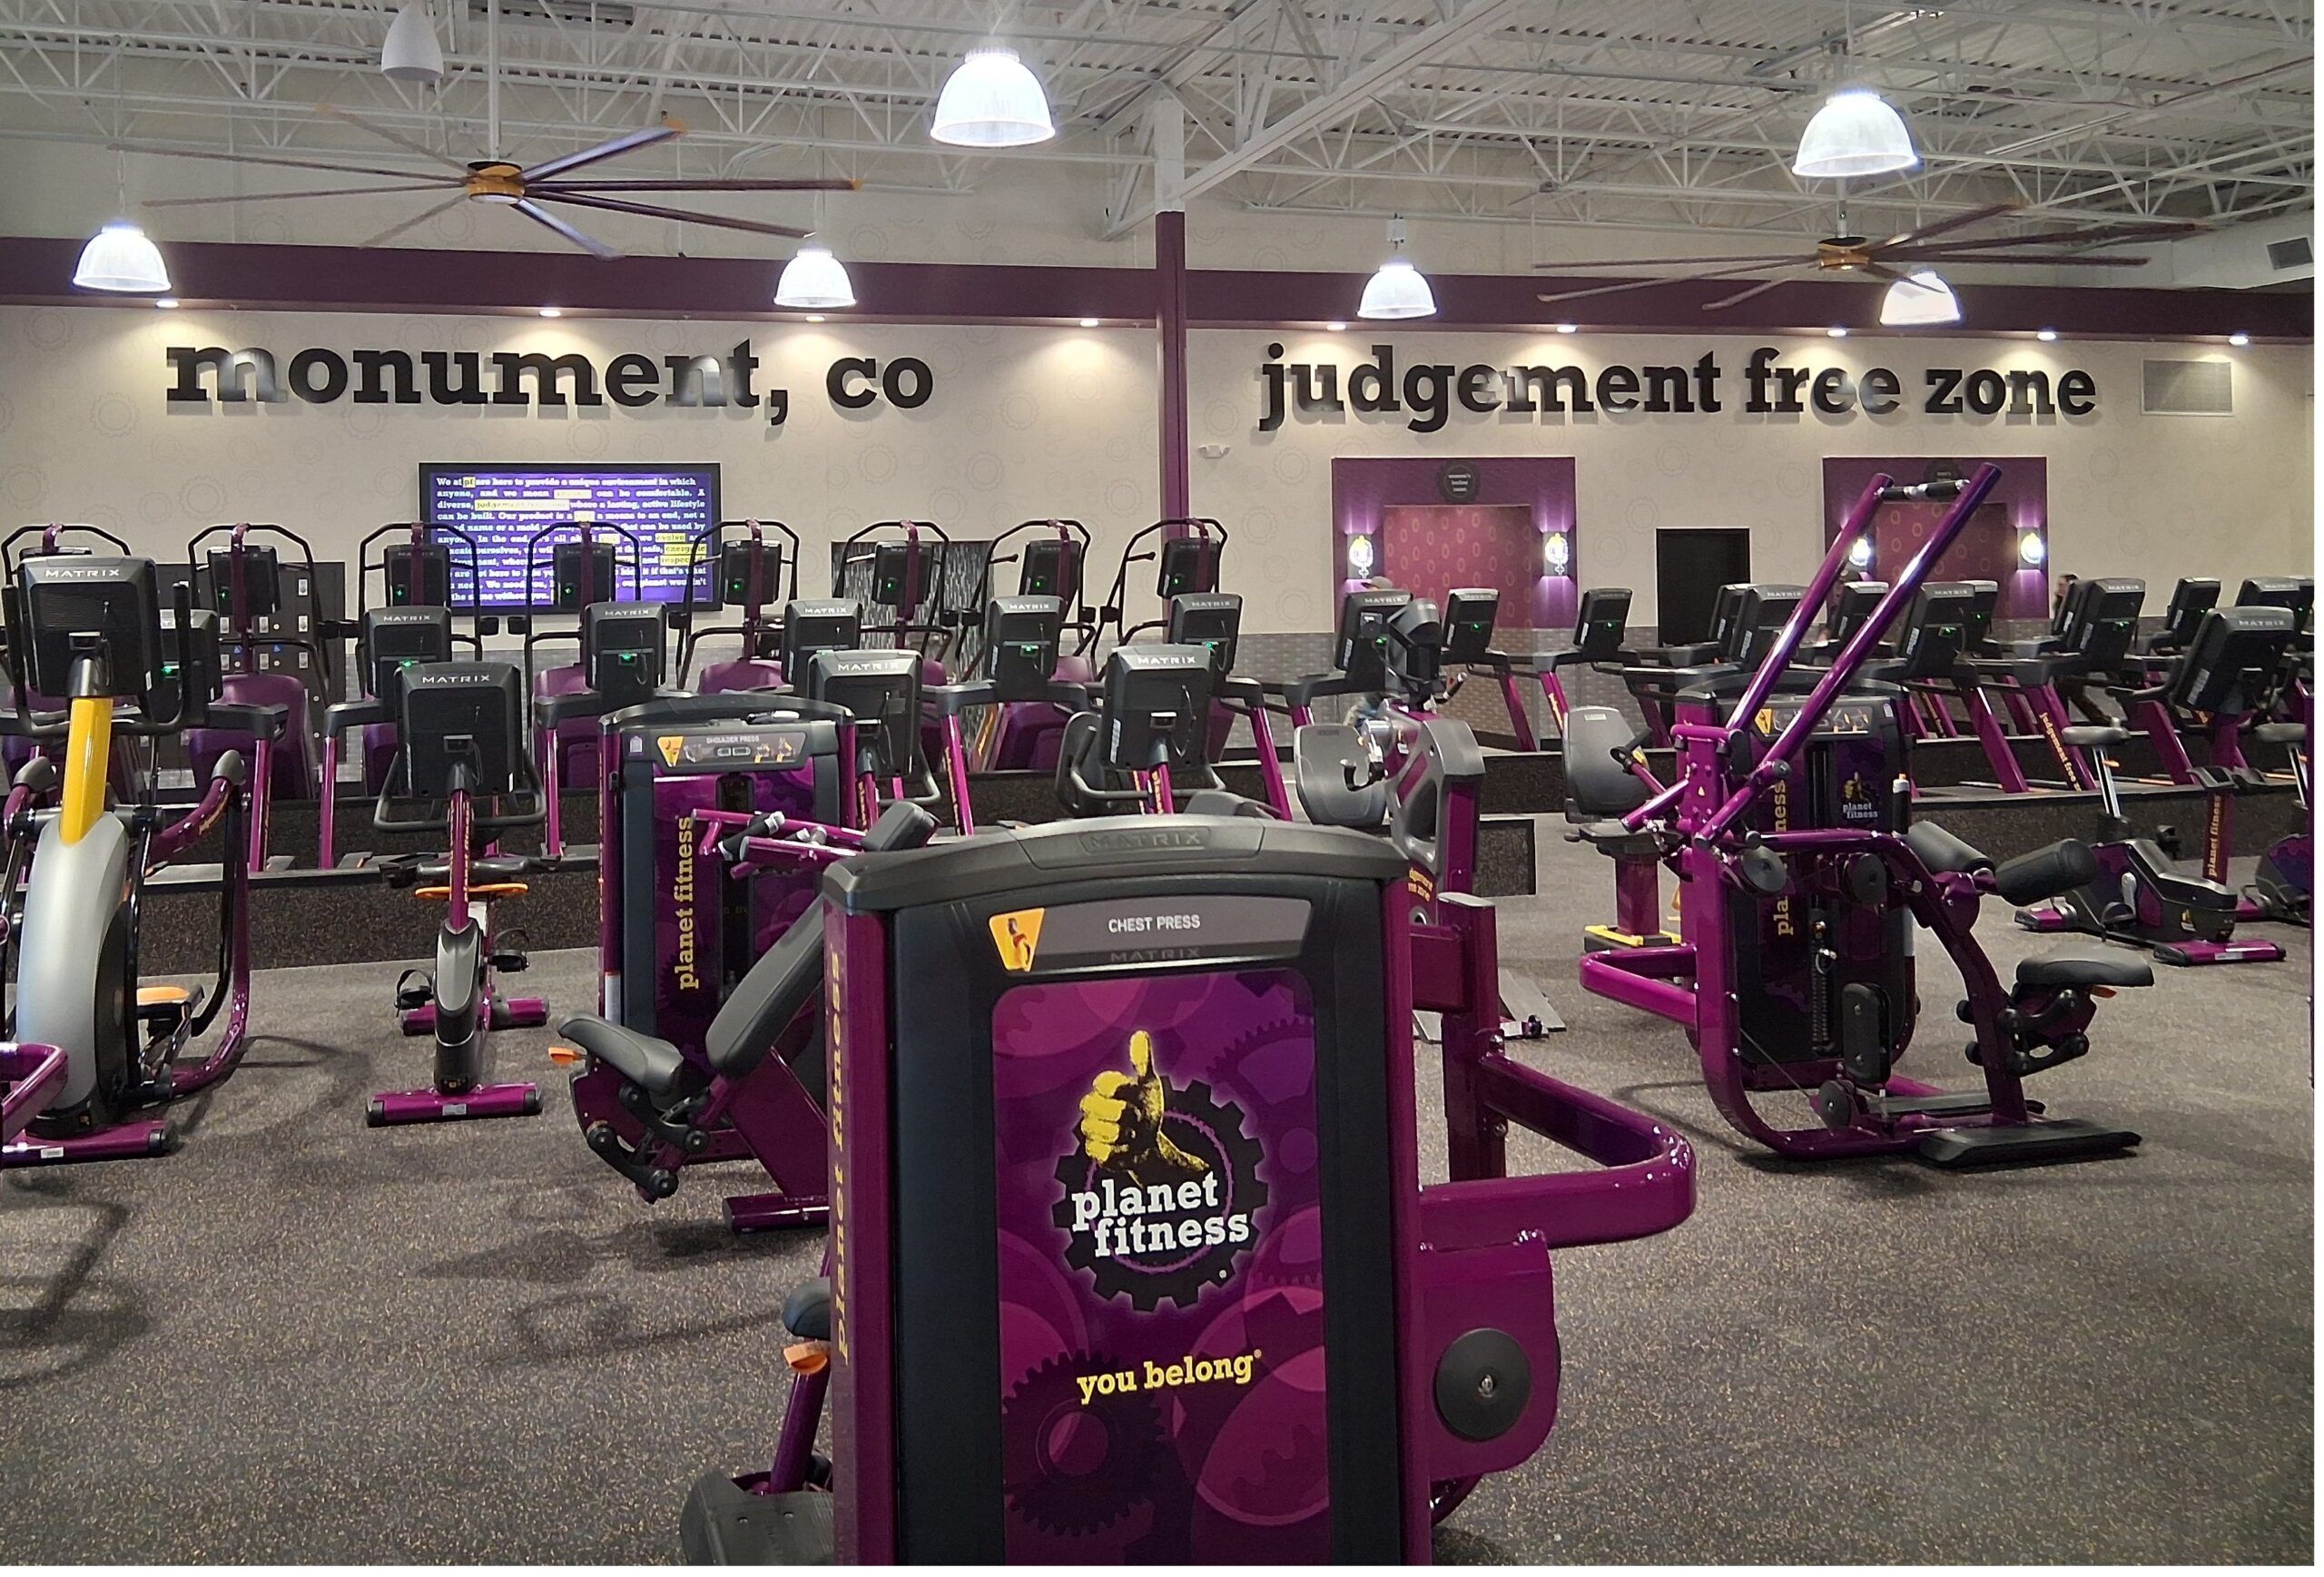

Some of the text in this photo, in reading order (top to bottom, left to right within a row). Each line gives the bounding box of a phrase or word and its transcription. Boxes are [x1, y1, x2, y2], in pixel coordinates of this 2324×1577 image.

[166, 338, 934, 426] monument, co
[1258, 342, 2097, 433] judgement free zone
[438, 501, 473, 509] diverse,
[671, 500, 704, 511] lifestyle
[471, 511, 495, 519] built.
[498, 511, 517, 519] Our
[662, 511, 680, 519] end,
[694, 523, 705, 531] by
[45, 568, 120, 577] MATRIX
[1364, 596, 1403, 604] MATRIX
[383, 615, 430, 623] MATRIX
[1137, 655, 1196, 665] MATRIX
[838, 663, 900, 672] MATRIX
[421, 674, 490, 684] MATRIX
[739, 735, 760, 744] PRESS
[1843, 802, 1872, 813] planet
[1846, 809, 1878, 819] fitness
[1092, 830, 1202, 851] MATRIX
[2208, 795, 2221, 878] planet fitness
[674, 816, 699, 991] planet fitness
[1108, 913, 1201, 933] CHEST PRESS
[1110, 947, 1201, 963] MATRIX
[832, 951, 849, 1366] planet fitness
[1071, 1170, 1218, 1233] planet
[1094, 1213, 1249, 1258] fitness
[1077, 1370, 1137, 1405] you
